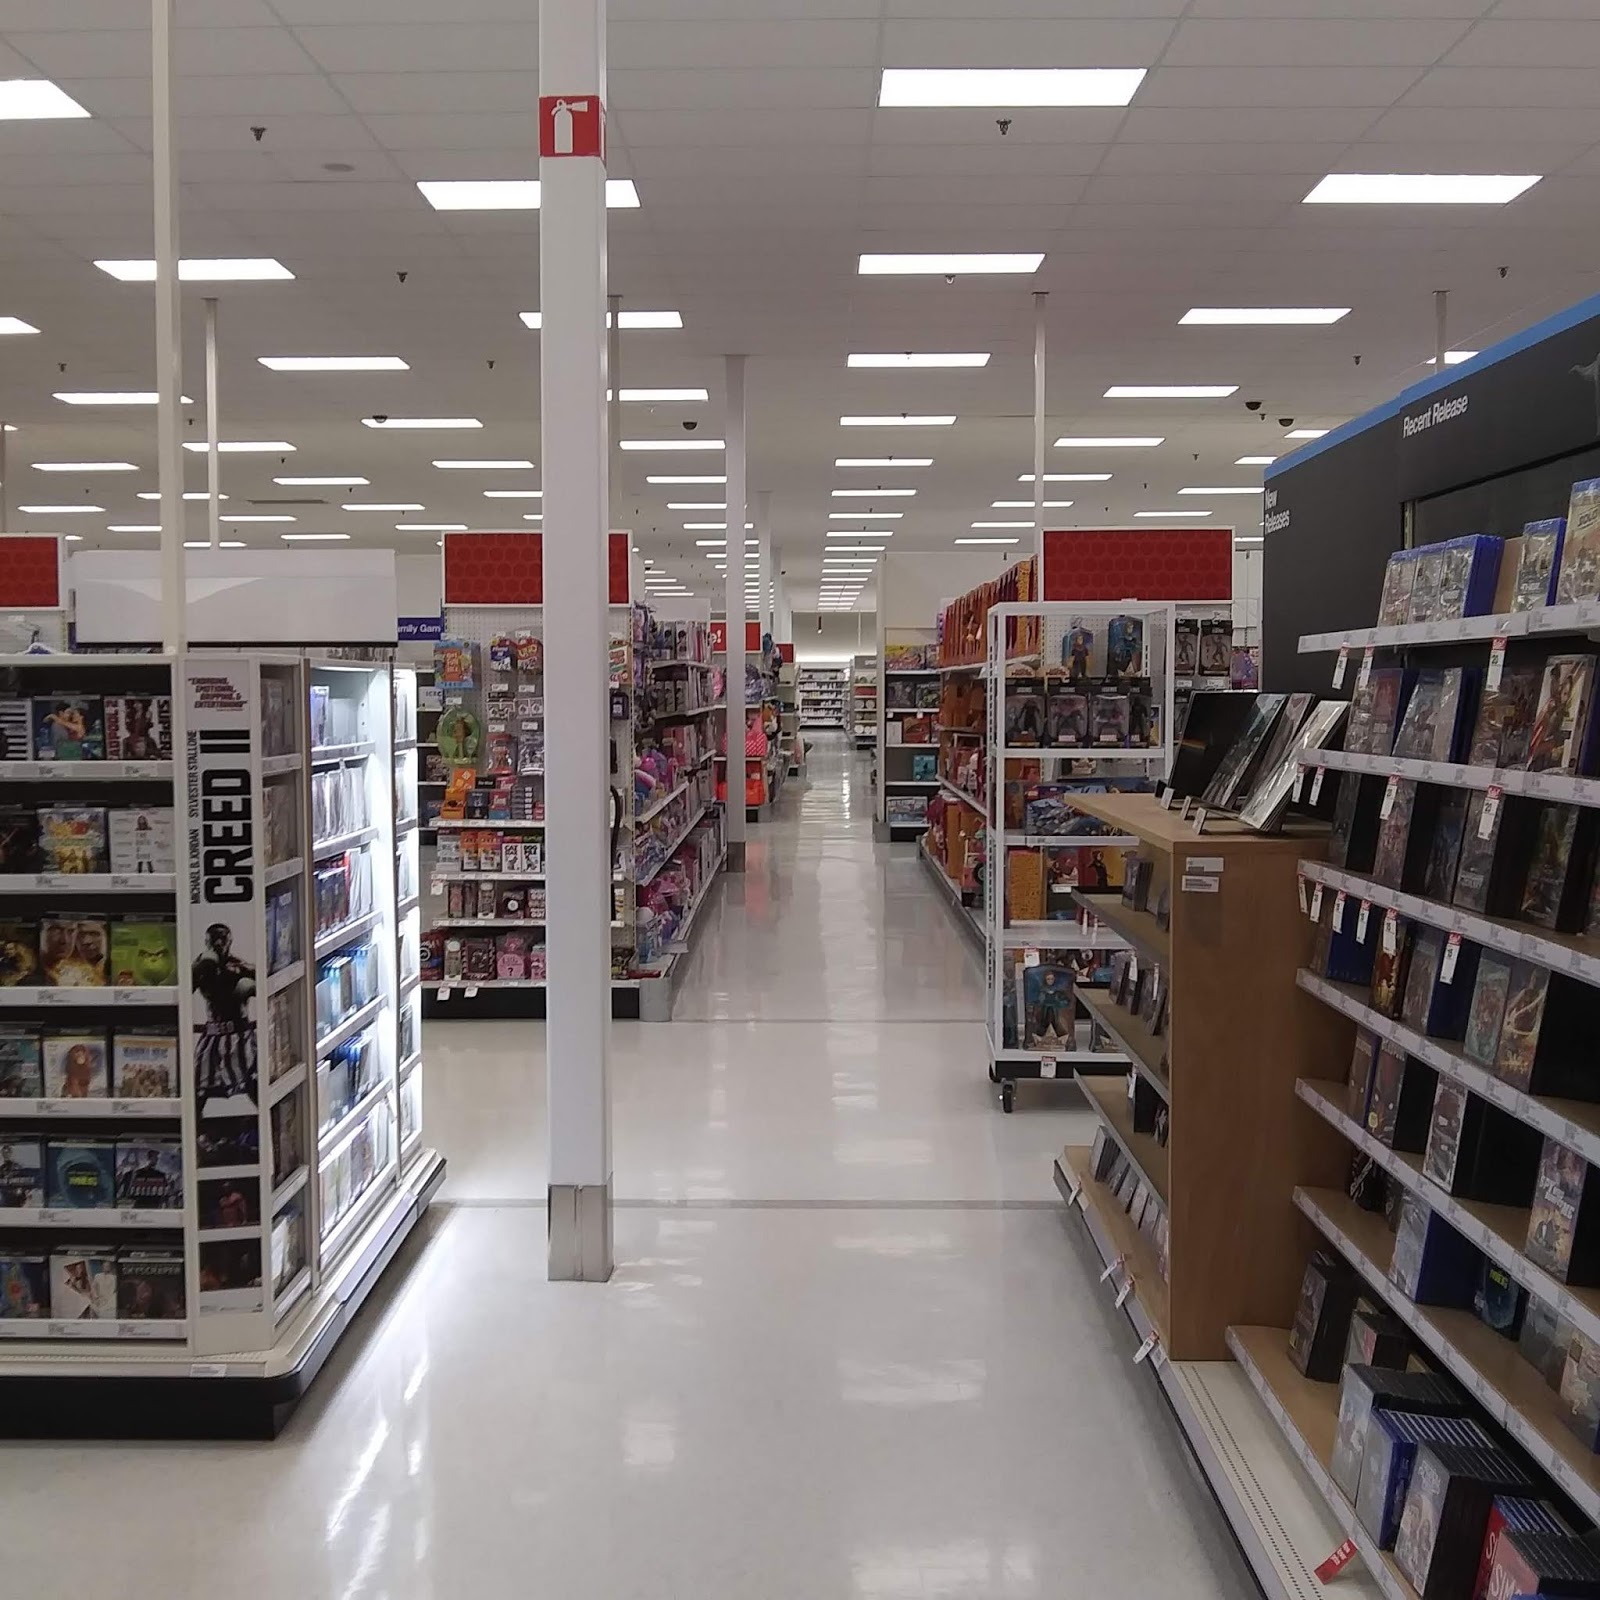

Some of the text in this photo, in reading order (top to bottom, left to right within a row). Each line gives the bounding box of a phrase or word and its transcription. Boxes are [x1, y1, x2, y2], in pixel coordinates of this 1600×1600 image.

[1403, 395, 1469, 439] Recent Release
[1265, 489, 1278, 510] New
[1265, 509, 1290, 535] Releases
[158, 699, 173, 752] SUPER
[200, 729, 250, 753] II
[186, 729, 198, 771] STALLONE
[187, 772, 199, 819] SYLVESTER
[188, 828, 199, 859] JORDAN
[202, 769, 254, 903] CREED
[189, 869, 201, 905] MICHAEL
